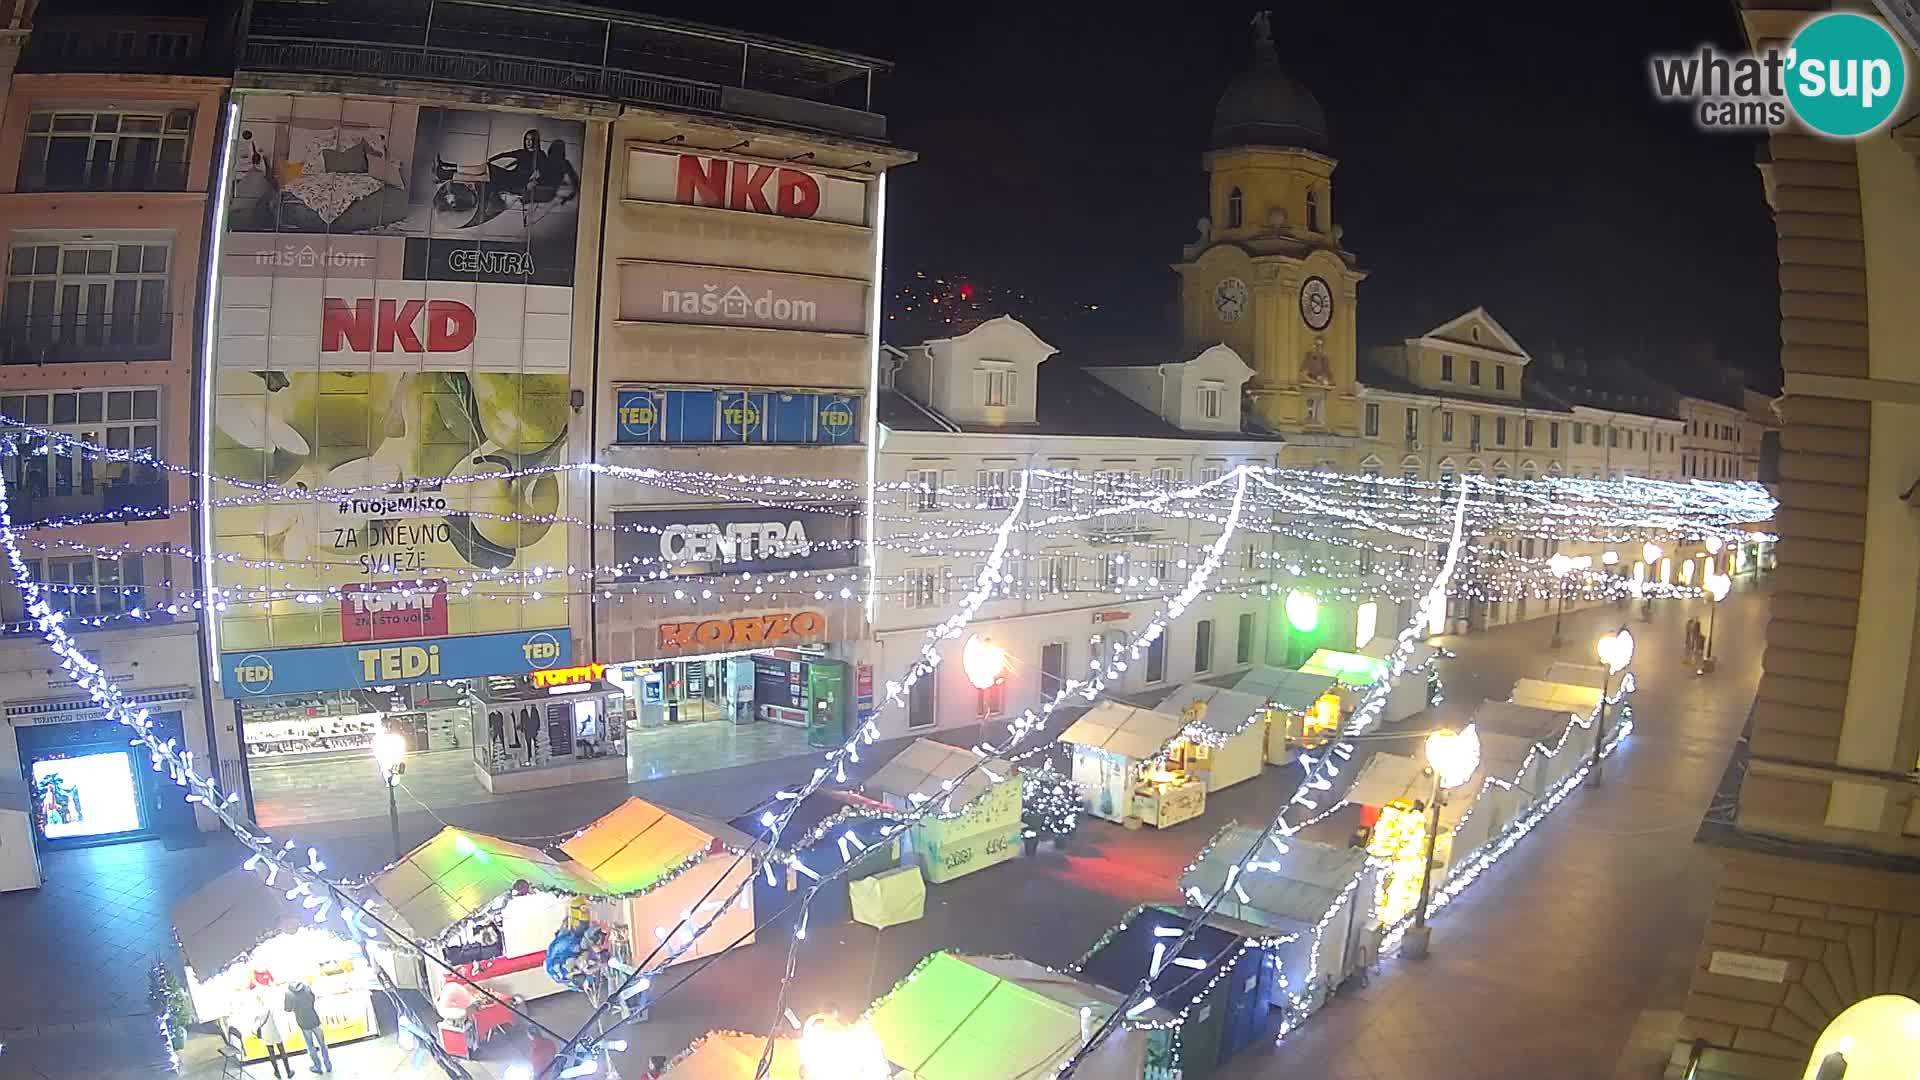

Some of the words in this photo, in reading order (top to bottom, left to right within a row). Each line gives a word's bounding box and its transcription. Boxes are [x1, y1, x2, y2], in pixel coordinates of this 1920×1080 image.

[675, 154, 821, 219] NKD
[255, 244, 295, 266] naš
[320, 245, 366, 267] dom
[448, 249, 535, 275] CENTRA
[661, 284, 718, 316] naš
[754, 290, 817, 322] dom
[321, 298, 477, 352] NKD
[619, 407, 658, 424] TEDi
[723, 408, 760, 425] TEDi
[339, 496, 447, 515] #TvojeMisto
[334, 528, 358, 548] ZA
[369, 524, 450, 547] DNEVNO
[660, 520, 810, 562] CENTRA
[658, 611, 826, 650] KORZO
[358, 644, 440, 681] TEDi
[522, 642, 560, 660] TEDi
[233, 666, 273, 682] TEDi
[533, 662, 605, 688] TOMMY
